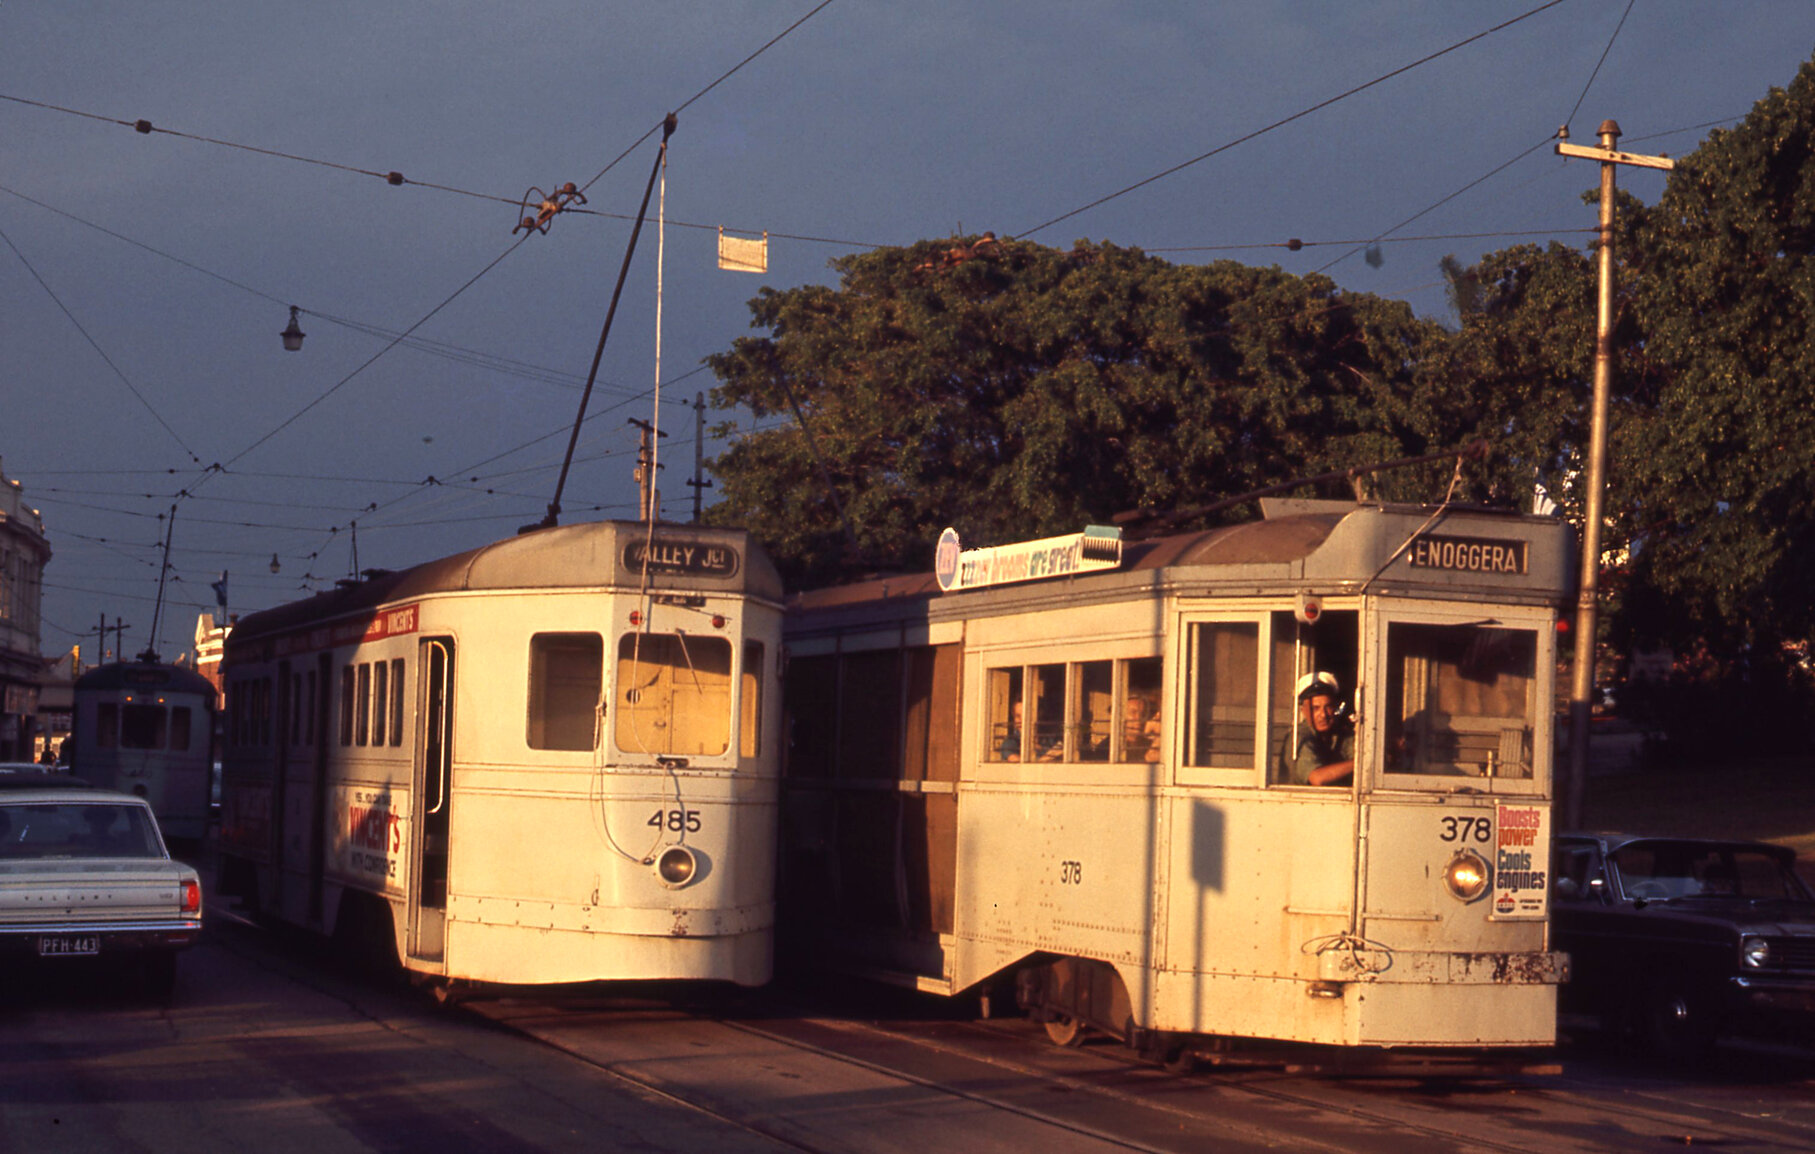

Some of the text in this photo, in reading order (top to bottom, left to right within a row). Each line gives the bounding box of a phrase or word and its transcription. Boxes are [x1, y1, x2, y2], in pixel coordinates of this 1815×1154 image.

[1416, 540, 1517, 572] ENOGGERA
[647, 809, 701, 833] 485
[1498, 806, 1540, 828] Boosts
[350, 805, 401, 854] VINCENT'S
[1440, 816, 1491, 843] 378
[1498, 828, 1537, 850] power
[1497, 849, 1532, 871] Cools
[1060, 860, 1082, 885] 378
[1497, 871, 1545, 893] engines
